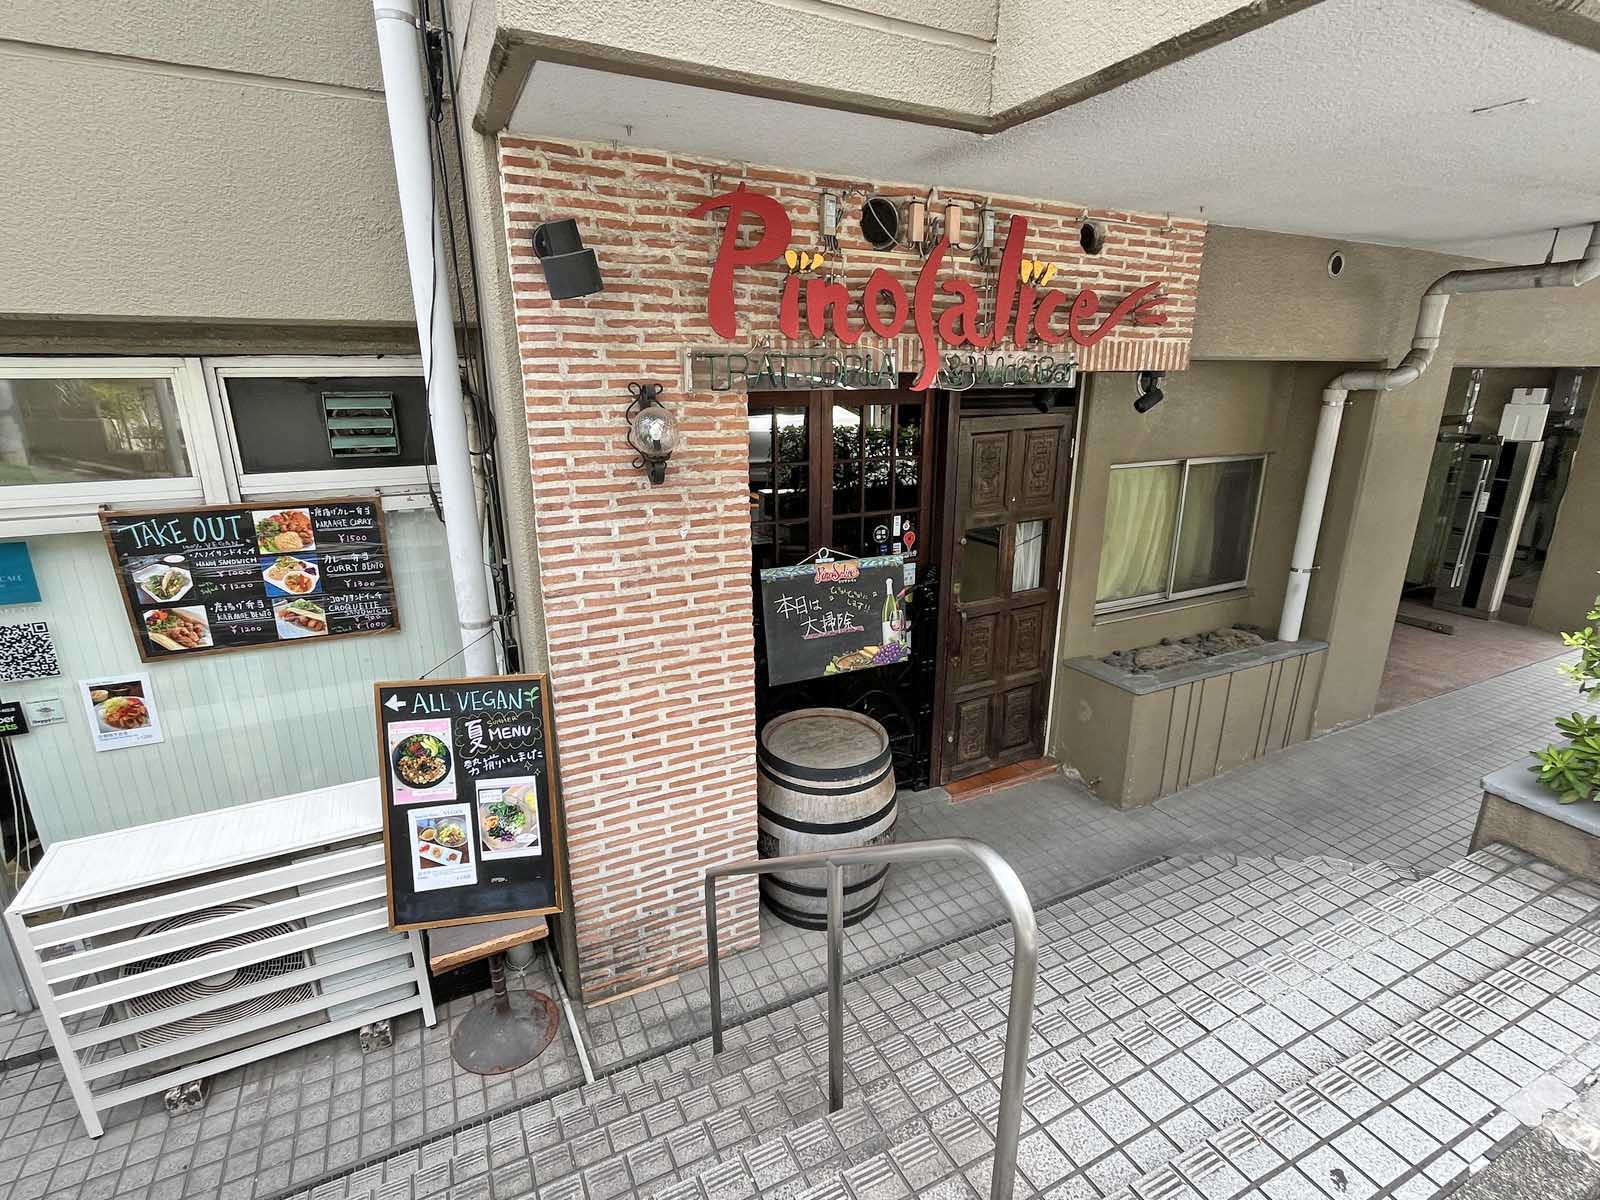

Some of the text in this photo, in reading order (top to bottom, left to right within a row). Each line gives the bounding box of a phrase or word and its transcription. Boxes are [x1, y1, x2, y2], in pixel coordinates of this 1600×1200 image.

[696, 351, 897, 391] TRATTORIA
[117, 514, 242, 549] TAKE OUT
[218, 557, 257, 566] SANDWICH
[326, 563, 358, 573] CURRY
[328, 601, 380, 611] CROQUETTE
[774, 593, 823, 620] 本日は
[801, 611, 856, 637] 大掃除
[411, 687, 523, 714] ALL VEGAN
[465, 719, 531, 753] 夏 MENU
